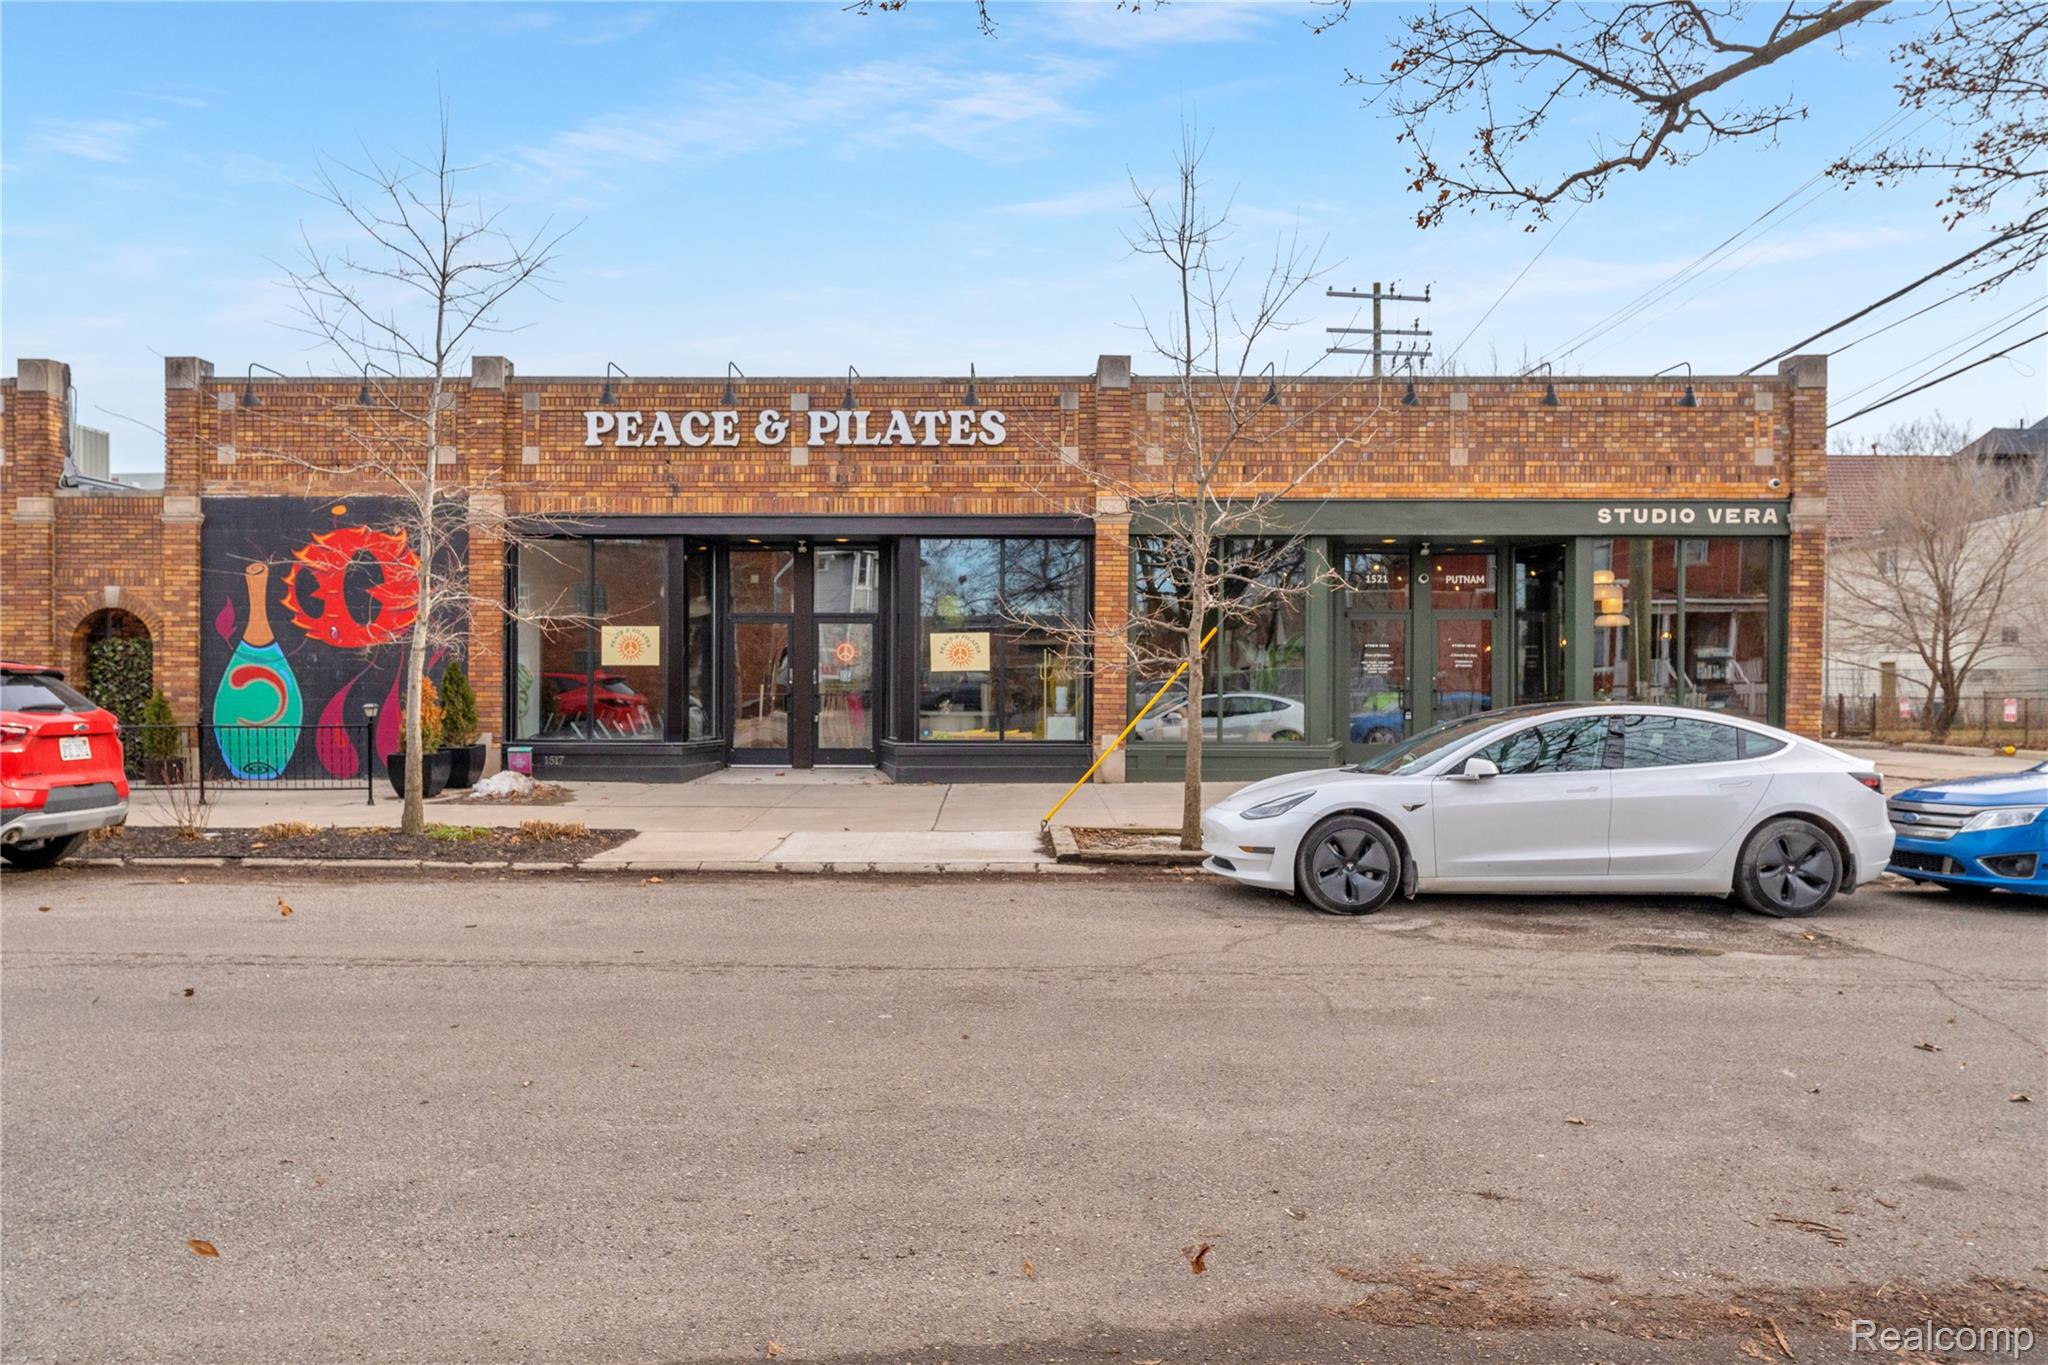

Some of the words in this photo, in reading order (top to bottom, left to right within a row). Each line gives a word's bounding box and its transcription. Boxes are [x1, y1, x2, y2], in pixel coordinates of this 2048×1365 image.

[583, 410, 741, 447] PEACE
[754, 409, 790, 446] &
[807, 410, 1007, 447] PILATES
[1597, 508, 1696, 524] STUDIO
[1707, 508, 1778, 524] VERA
[1365, 574, 1389, 584] 1521
[1445, 574, 1485, 585] PUTNAM
[544, 755, 565, 766] 1517
